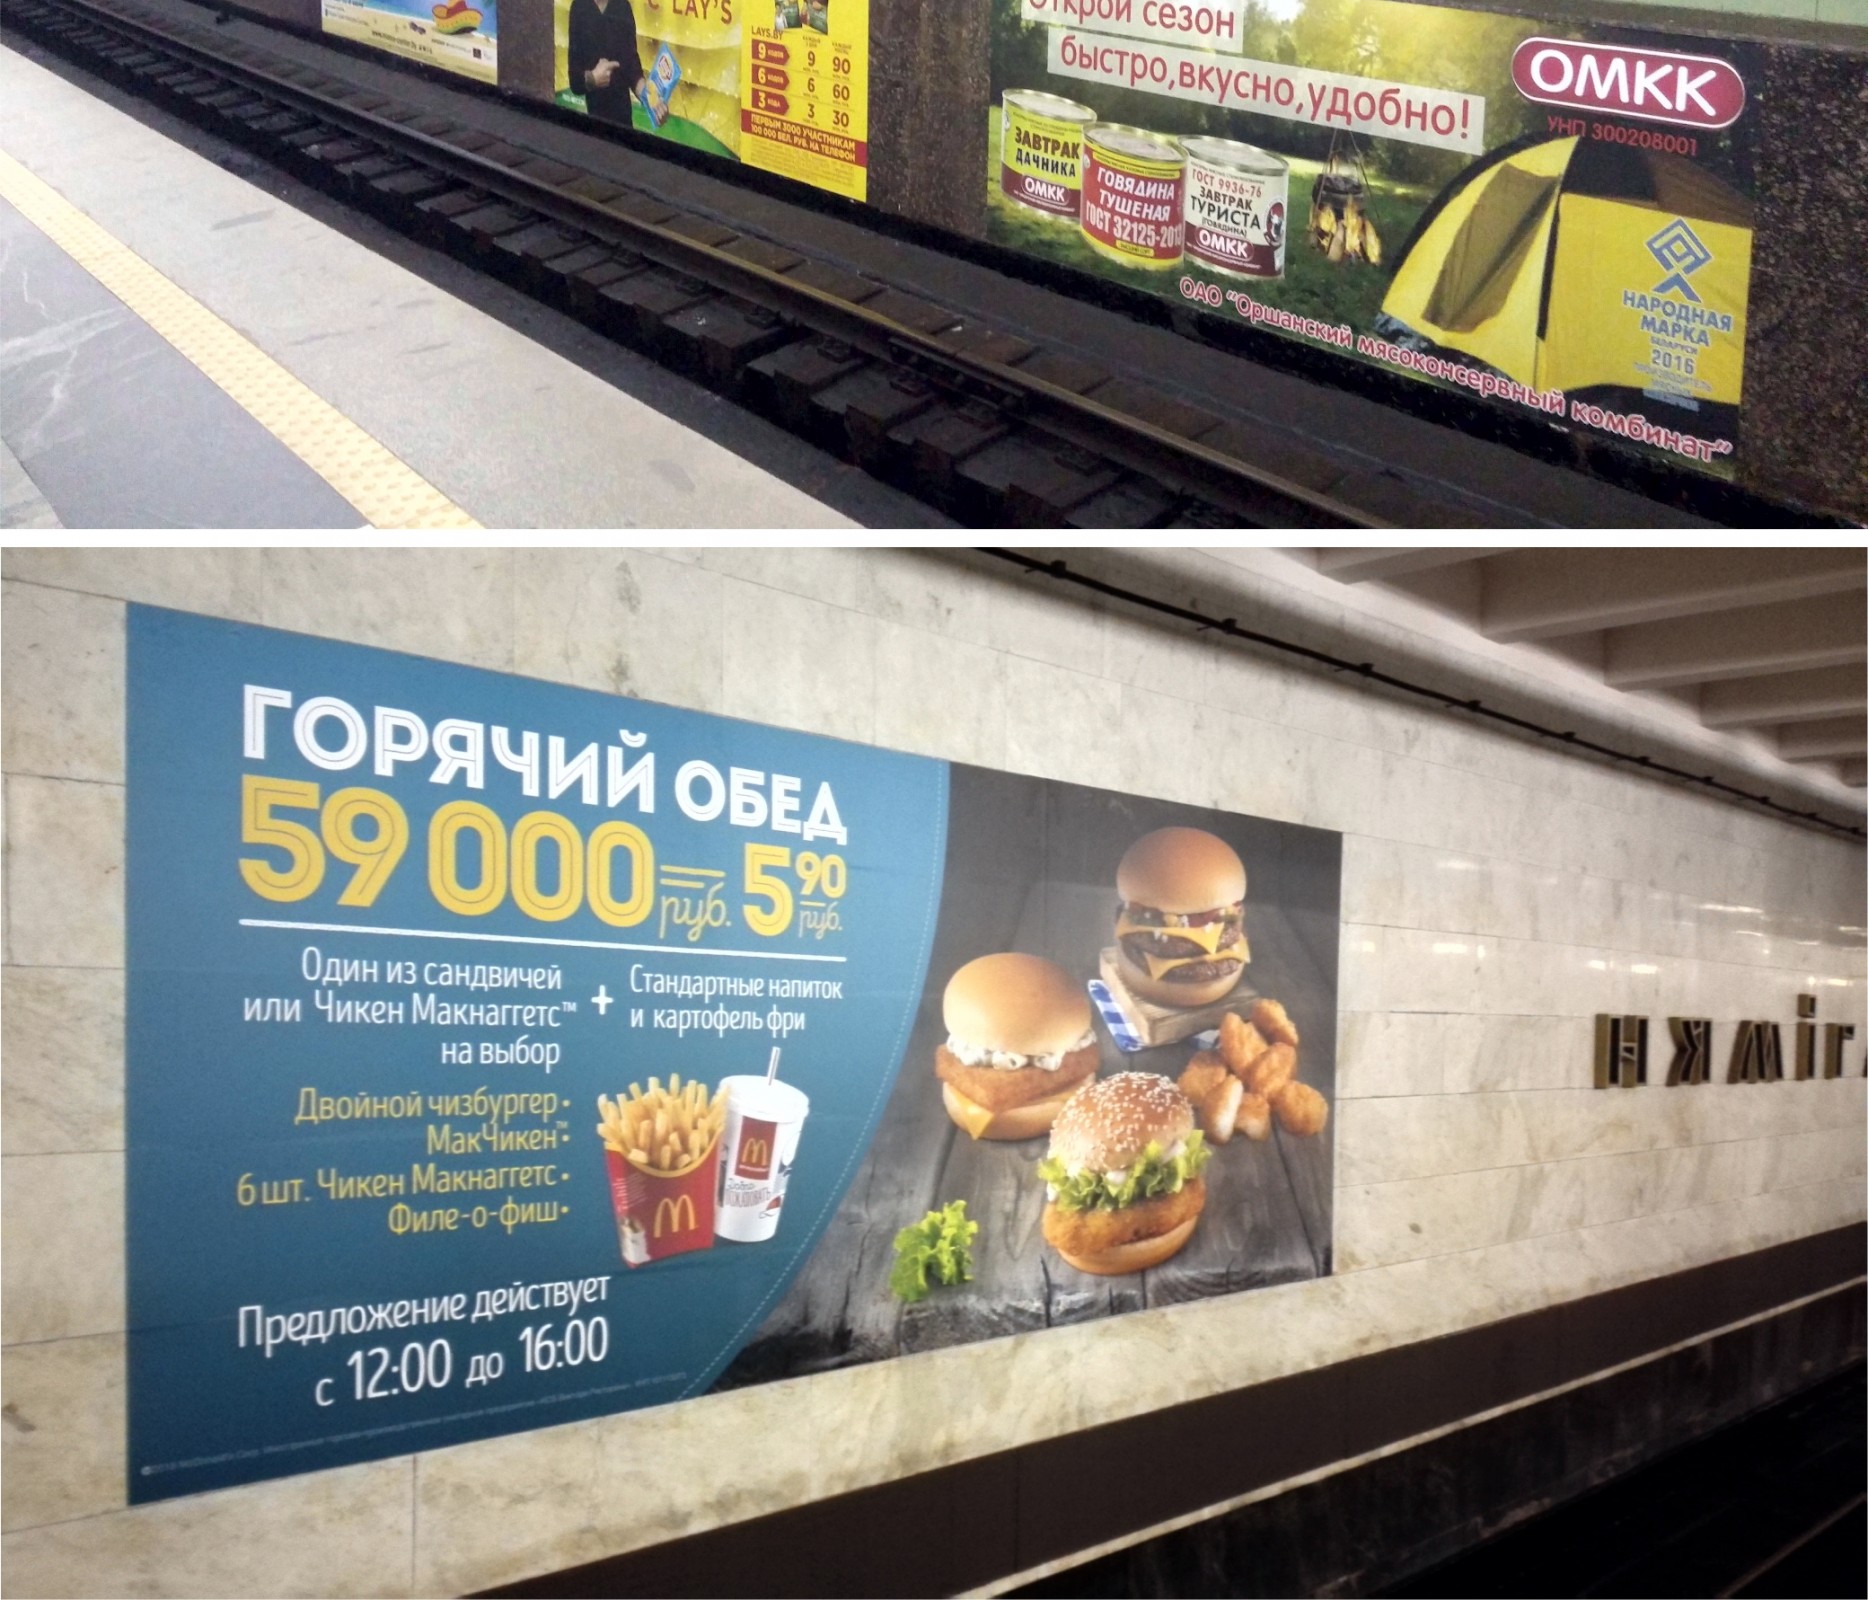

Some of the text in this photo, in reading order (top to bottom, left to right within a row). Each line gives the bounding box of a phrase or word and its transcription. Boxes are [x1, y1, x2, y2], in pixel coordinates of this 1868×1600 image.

[751, 24, 783, 40] LAYS.BY
[1143, 0, 1235, 39] сезон
[807, 50, 816, 67] 9
[832, 56, 851, 75] 90
[807, 77, 816, 93] 6
[832, 83, 850, 101] 60
[1530, 49, 1718, 118] ОМКК
[807, 103, 815, 119] 3
[832, 110, 850, 128] 30
[1014, 125, 1081, 160] ЗАВТРАК
[1547, 114, 1697, 156] УНП 300208001
[1015, 147, 1076, 177] ДАЧНИКА
[1024, 177, 1066, 202] ОМКК
[1097, 166, 1175, 200] ГОВЯДИНА
[1192, 168, 1215, 187] ГОСТ
[1218, 178, 1262, 198] 9936-76
[1200, 186, 1253, 211] ЗАВТРАК
[1086, 201, 1112, 234] ГОСТ
[1099, 188, 1171, 222] ТУШЕНАЯ
[1191, 195, 1261, 230] ТУРИСТА
[1199, 229, 1248, 258] ОМКК
[1623, 289, 1733, 332] НАРОДНАЯ
[1179, 275, 1223, 308] ОАО
[1357, 330, 1565, 417] мясоконсервный
[1641, 314, 1710, 347] МАРКА
[1651, 349, 1695, 375] 2016
[242, 683, 657, 813] ГОРЯЧИЙ
[673, 760, 848, 845] ОБЕД
[238, 773, 848, 941] 59 000 руб. 5 90 руб.
[301, 946, 563, 994] Один из сандвичей
[629, 963, 844, 1003] Стандартные напиток
[243, 993, 302, 1024] или
[314, 995, 404, 1027] Чикен
[630, 1002, 807, 1037] и картофель фри
[440, 1036, 562, 1076] на выбор
[1593, 992, 1867, 1090] НЯМІГ
[294, 1087, 558, 1127] Двойной чизбургер
[236, 1164, 558, 1207] 6 шт. Чикен Макнаггетс
[387, 1199, 560, 1237] Филе-о-фиш
[237, 1275, 611, 1353] Предложение действует
[314, 1315, 610, 1407] с 12:00 до 16:00
